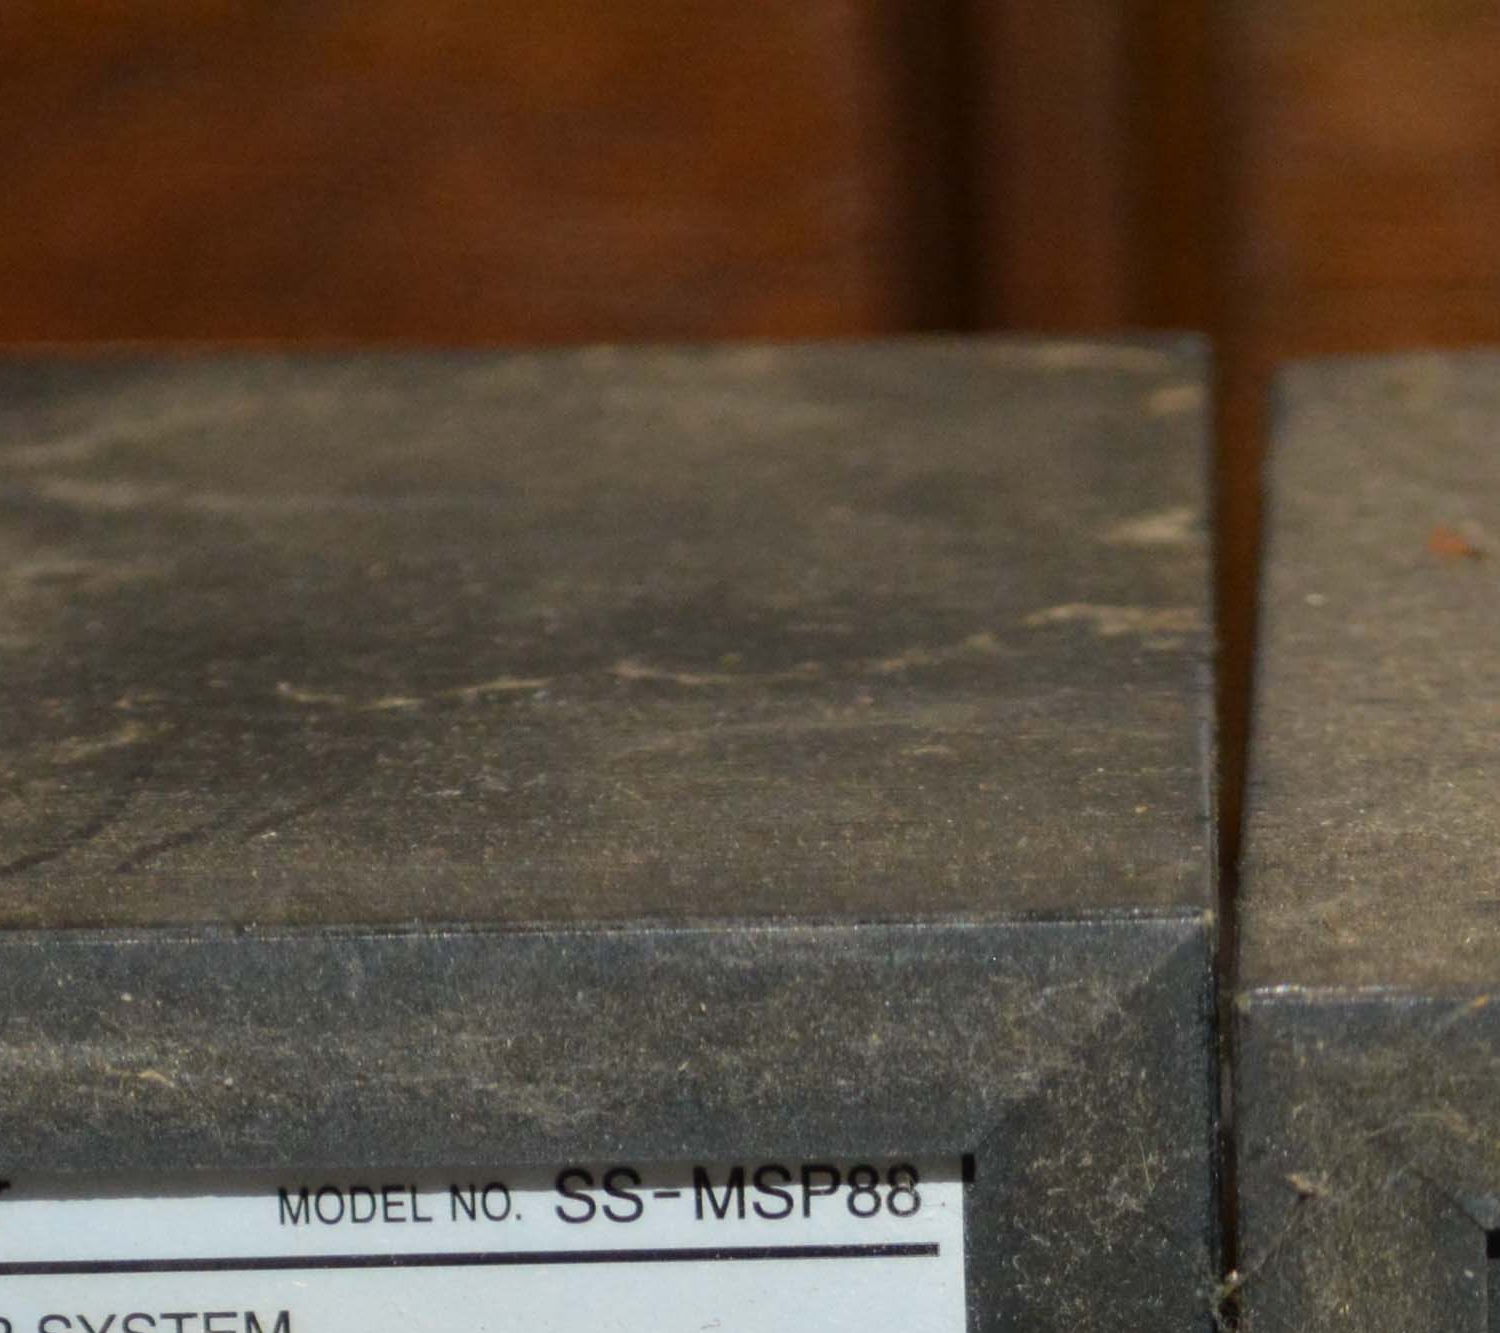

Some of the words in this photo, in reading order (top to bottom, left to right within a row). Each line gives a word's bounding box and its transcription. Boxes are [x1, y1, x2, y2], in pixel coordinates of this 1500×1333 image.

[278, 1184, 431, 1225] MODEL
[450, 1181, 521, 1222] NO.
[556, 1164, 922, 1223] SS-MSP88
